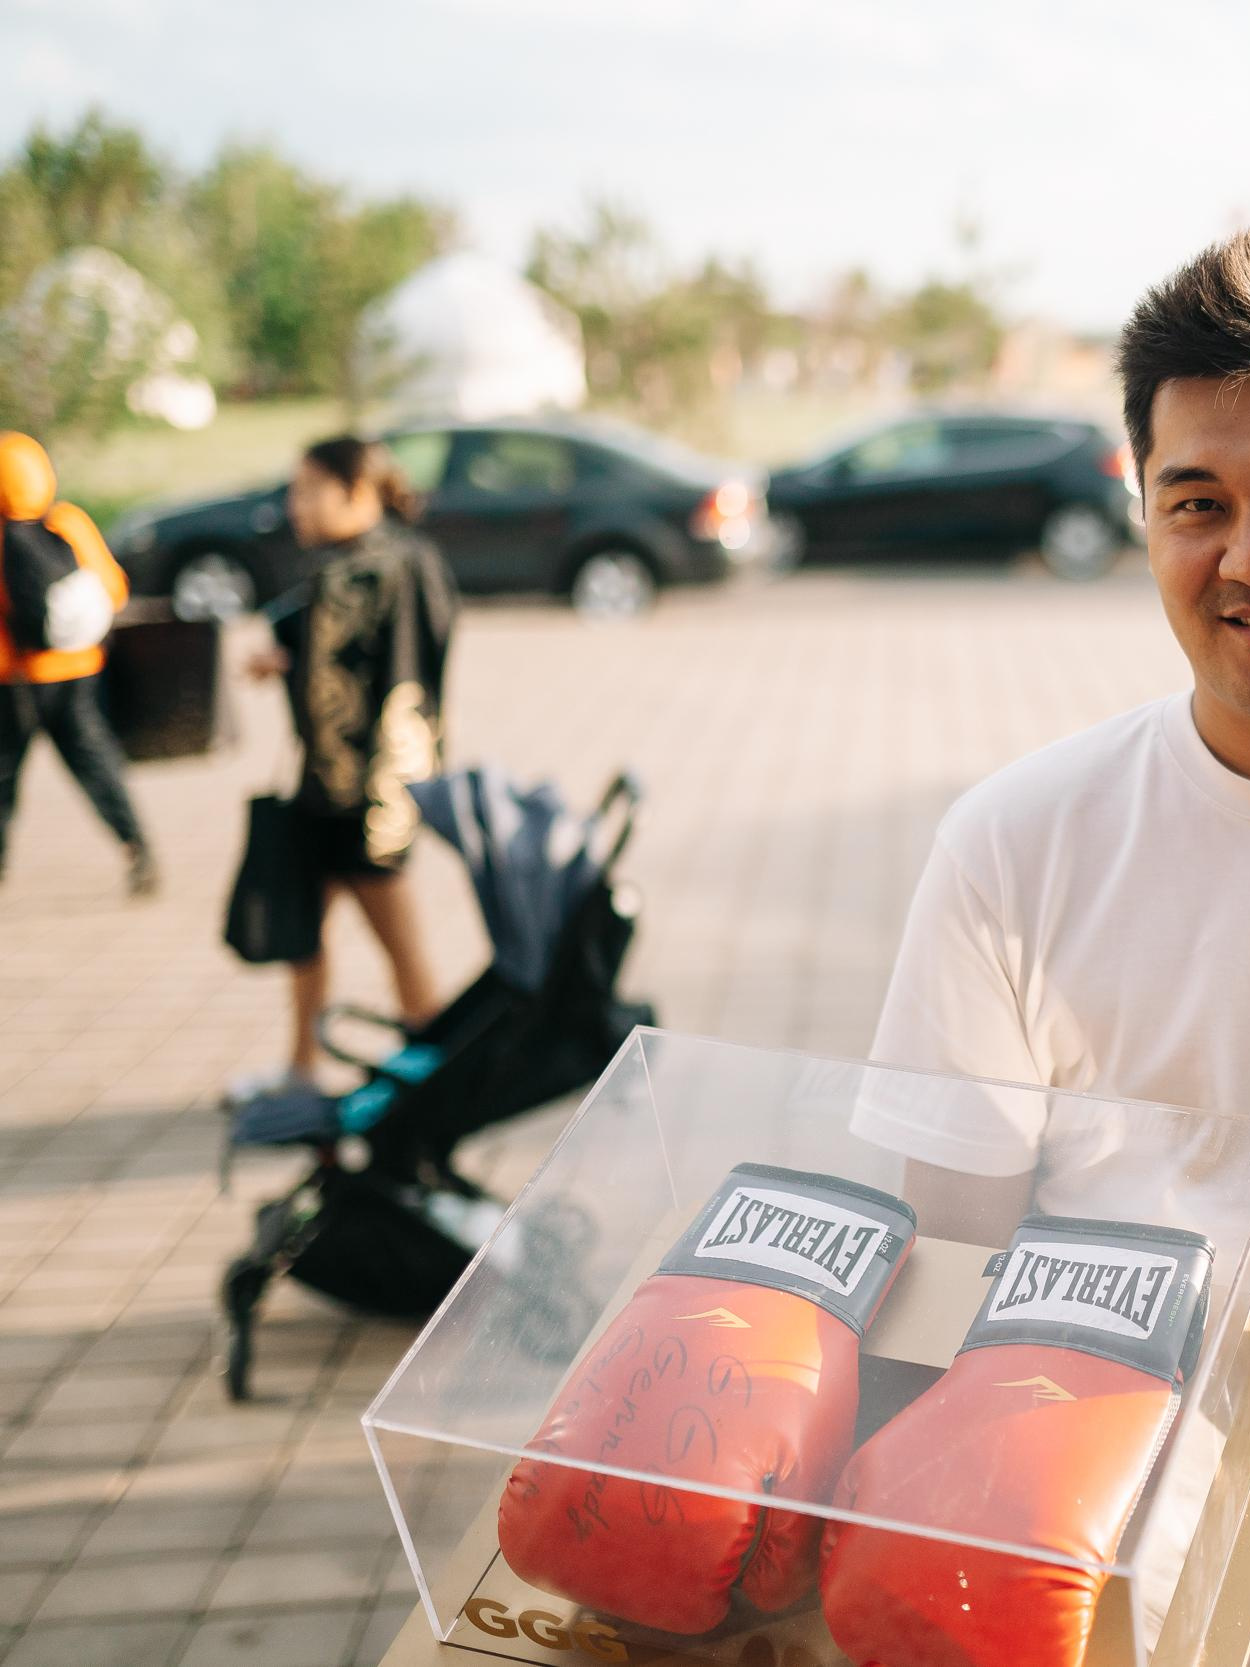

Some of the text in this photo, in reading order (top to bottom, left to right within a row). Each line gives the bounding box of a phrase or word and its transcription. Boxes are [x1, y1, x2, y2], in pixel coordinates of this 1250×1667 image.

[702, 1194, 880, 1289] EVERLAST
[995, 1249, 1174, 1332] EVERLAST
[463, 1597, 629, 1663] GGG
